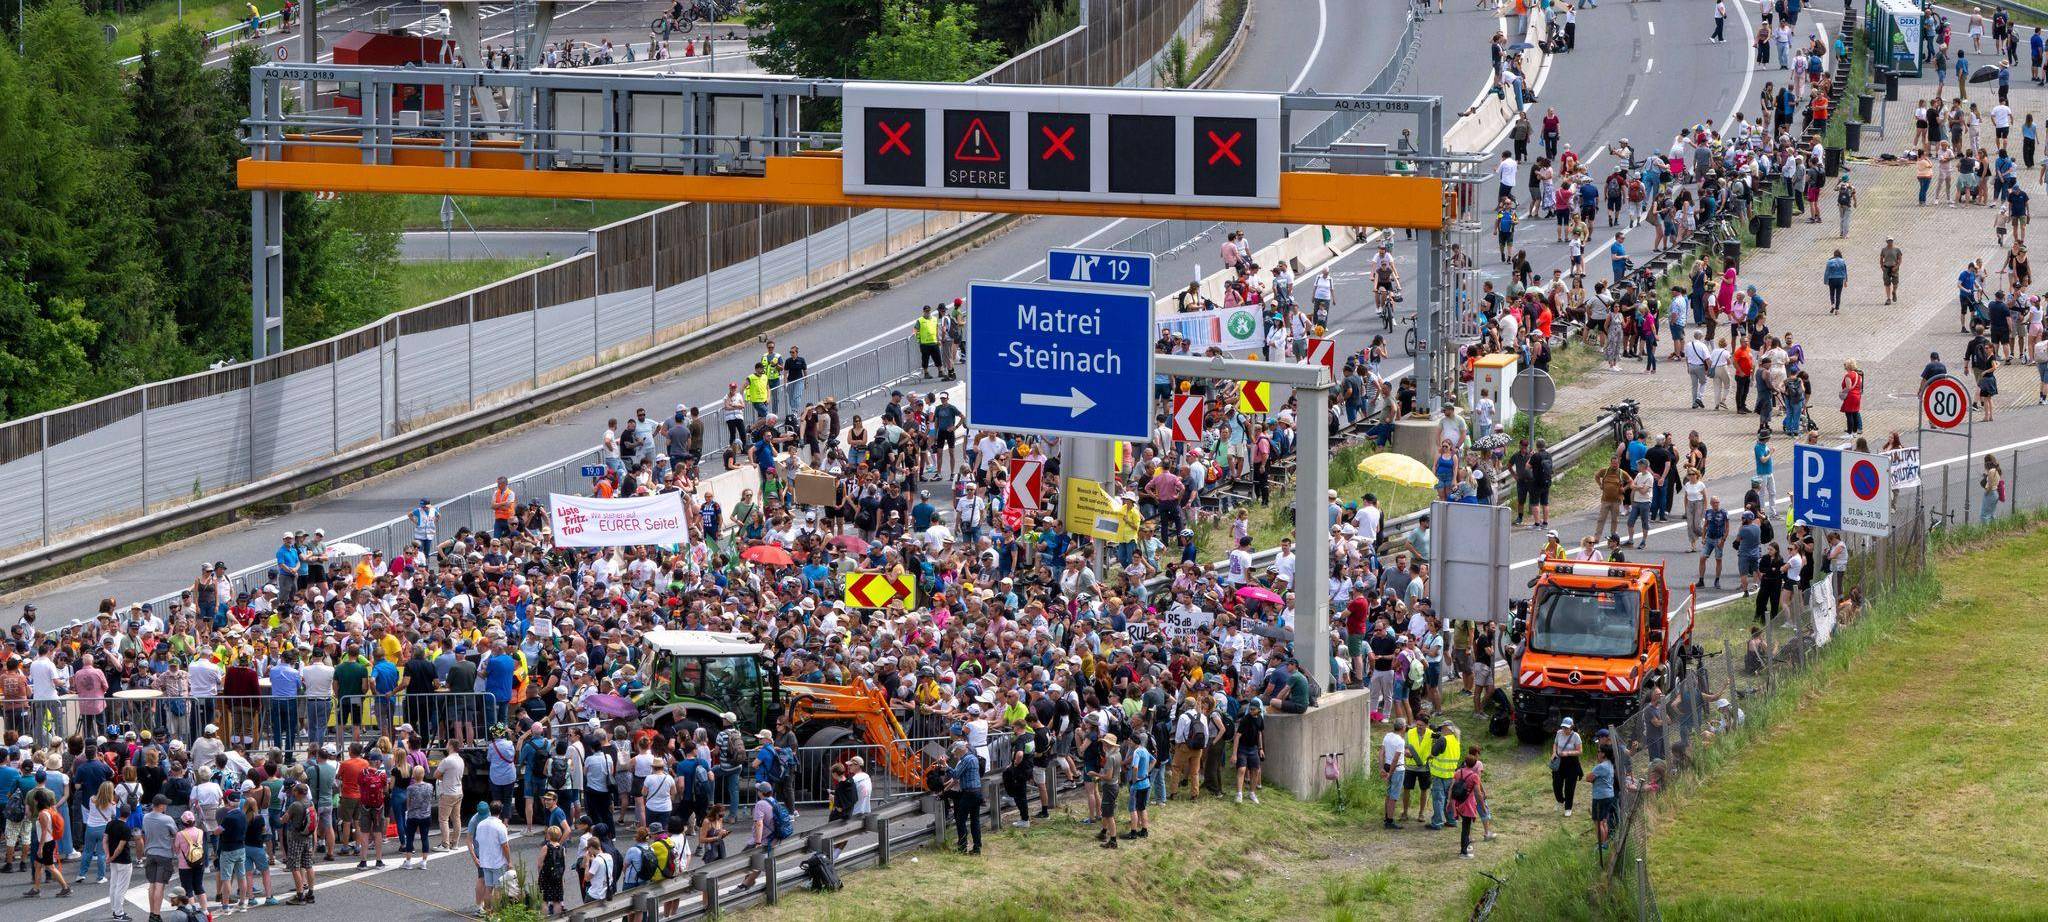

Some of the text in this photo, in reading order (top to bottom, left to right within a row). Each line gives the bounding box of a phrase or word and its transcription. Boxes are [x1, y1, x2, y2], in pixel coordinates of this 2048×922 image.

[949, 170, 1006, 185] SPERRE
[1108, 259, 1131, 281] 19
[1018, 304, 1101, 335] Matrei
[998, 341, 1121, 375] -Steinach
[1933, 391, 1957, 417] 80
[1802, 450, 1825, 500] P
[557, 506, 580, 517] Liste
[564, 514, 589, 526] Fritz.
[600, 516, 680, 532] EURER Seite!
[562, 523, 584, 536] Tirol
[1167, 613, 1192, 627] 85 dB
